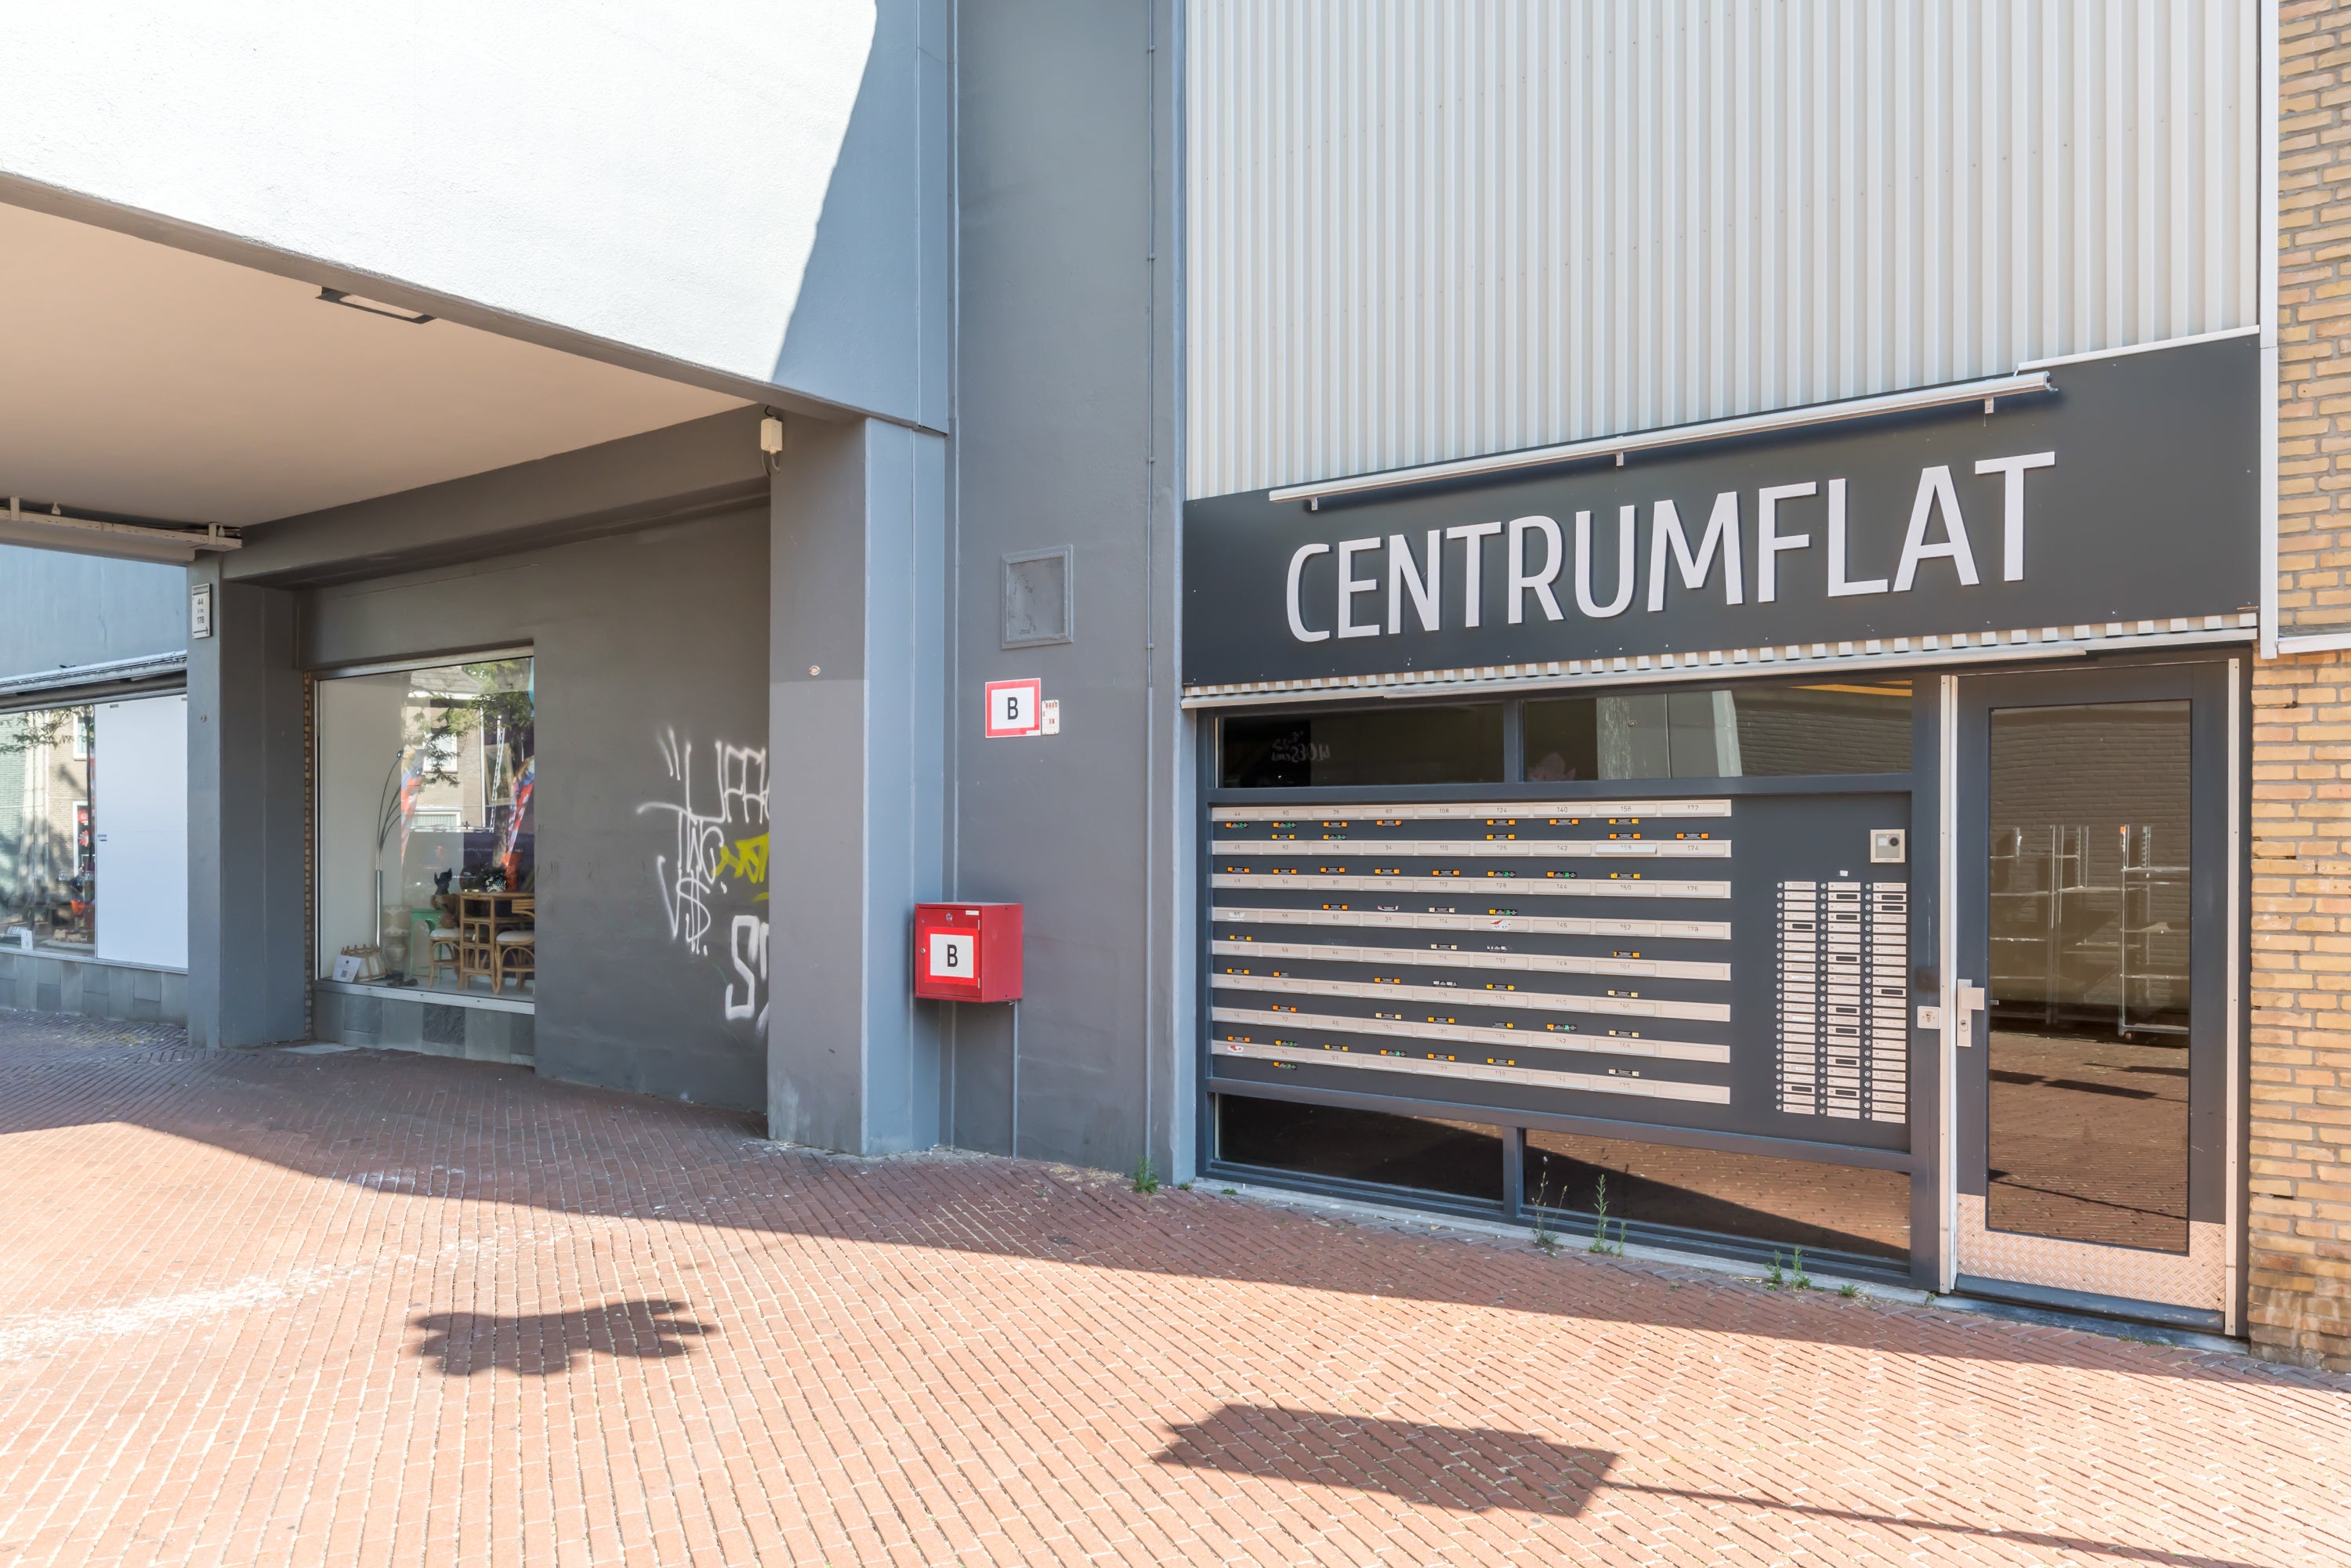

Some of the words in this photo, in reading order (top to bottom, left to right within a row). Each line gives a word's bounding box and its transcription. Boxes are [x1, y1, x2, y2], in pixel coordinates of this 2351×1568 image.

[1286, 451, 2055, 643] CENTRUMFLAT
[1007, 697, 1019, 720] B
[947, 944, 958, 967] B
